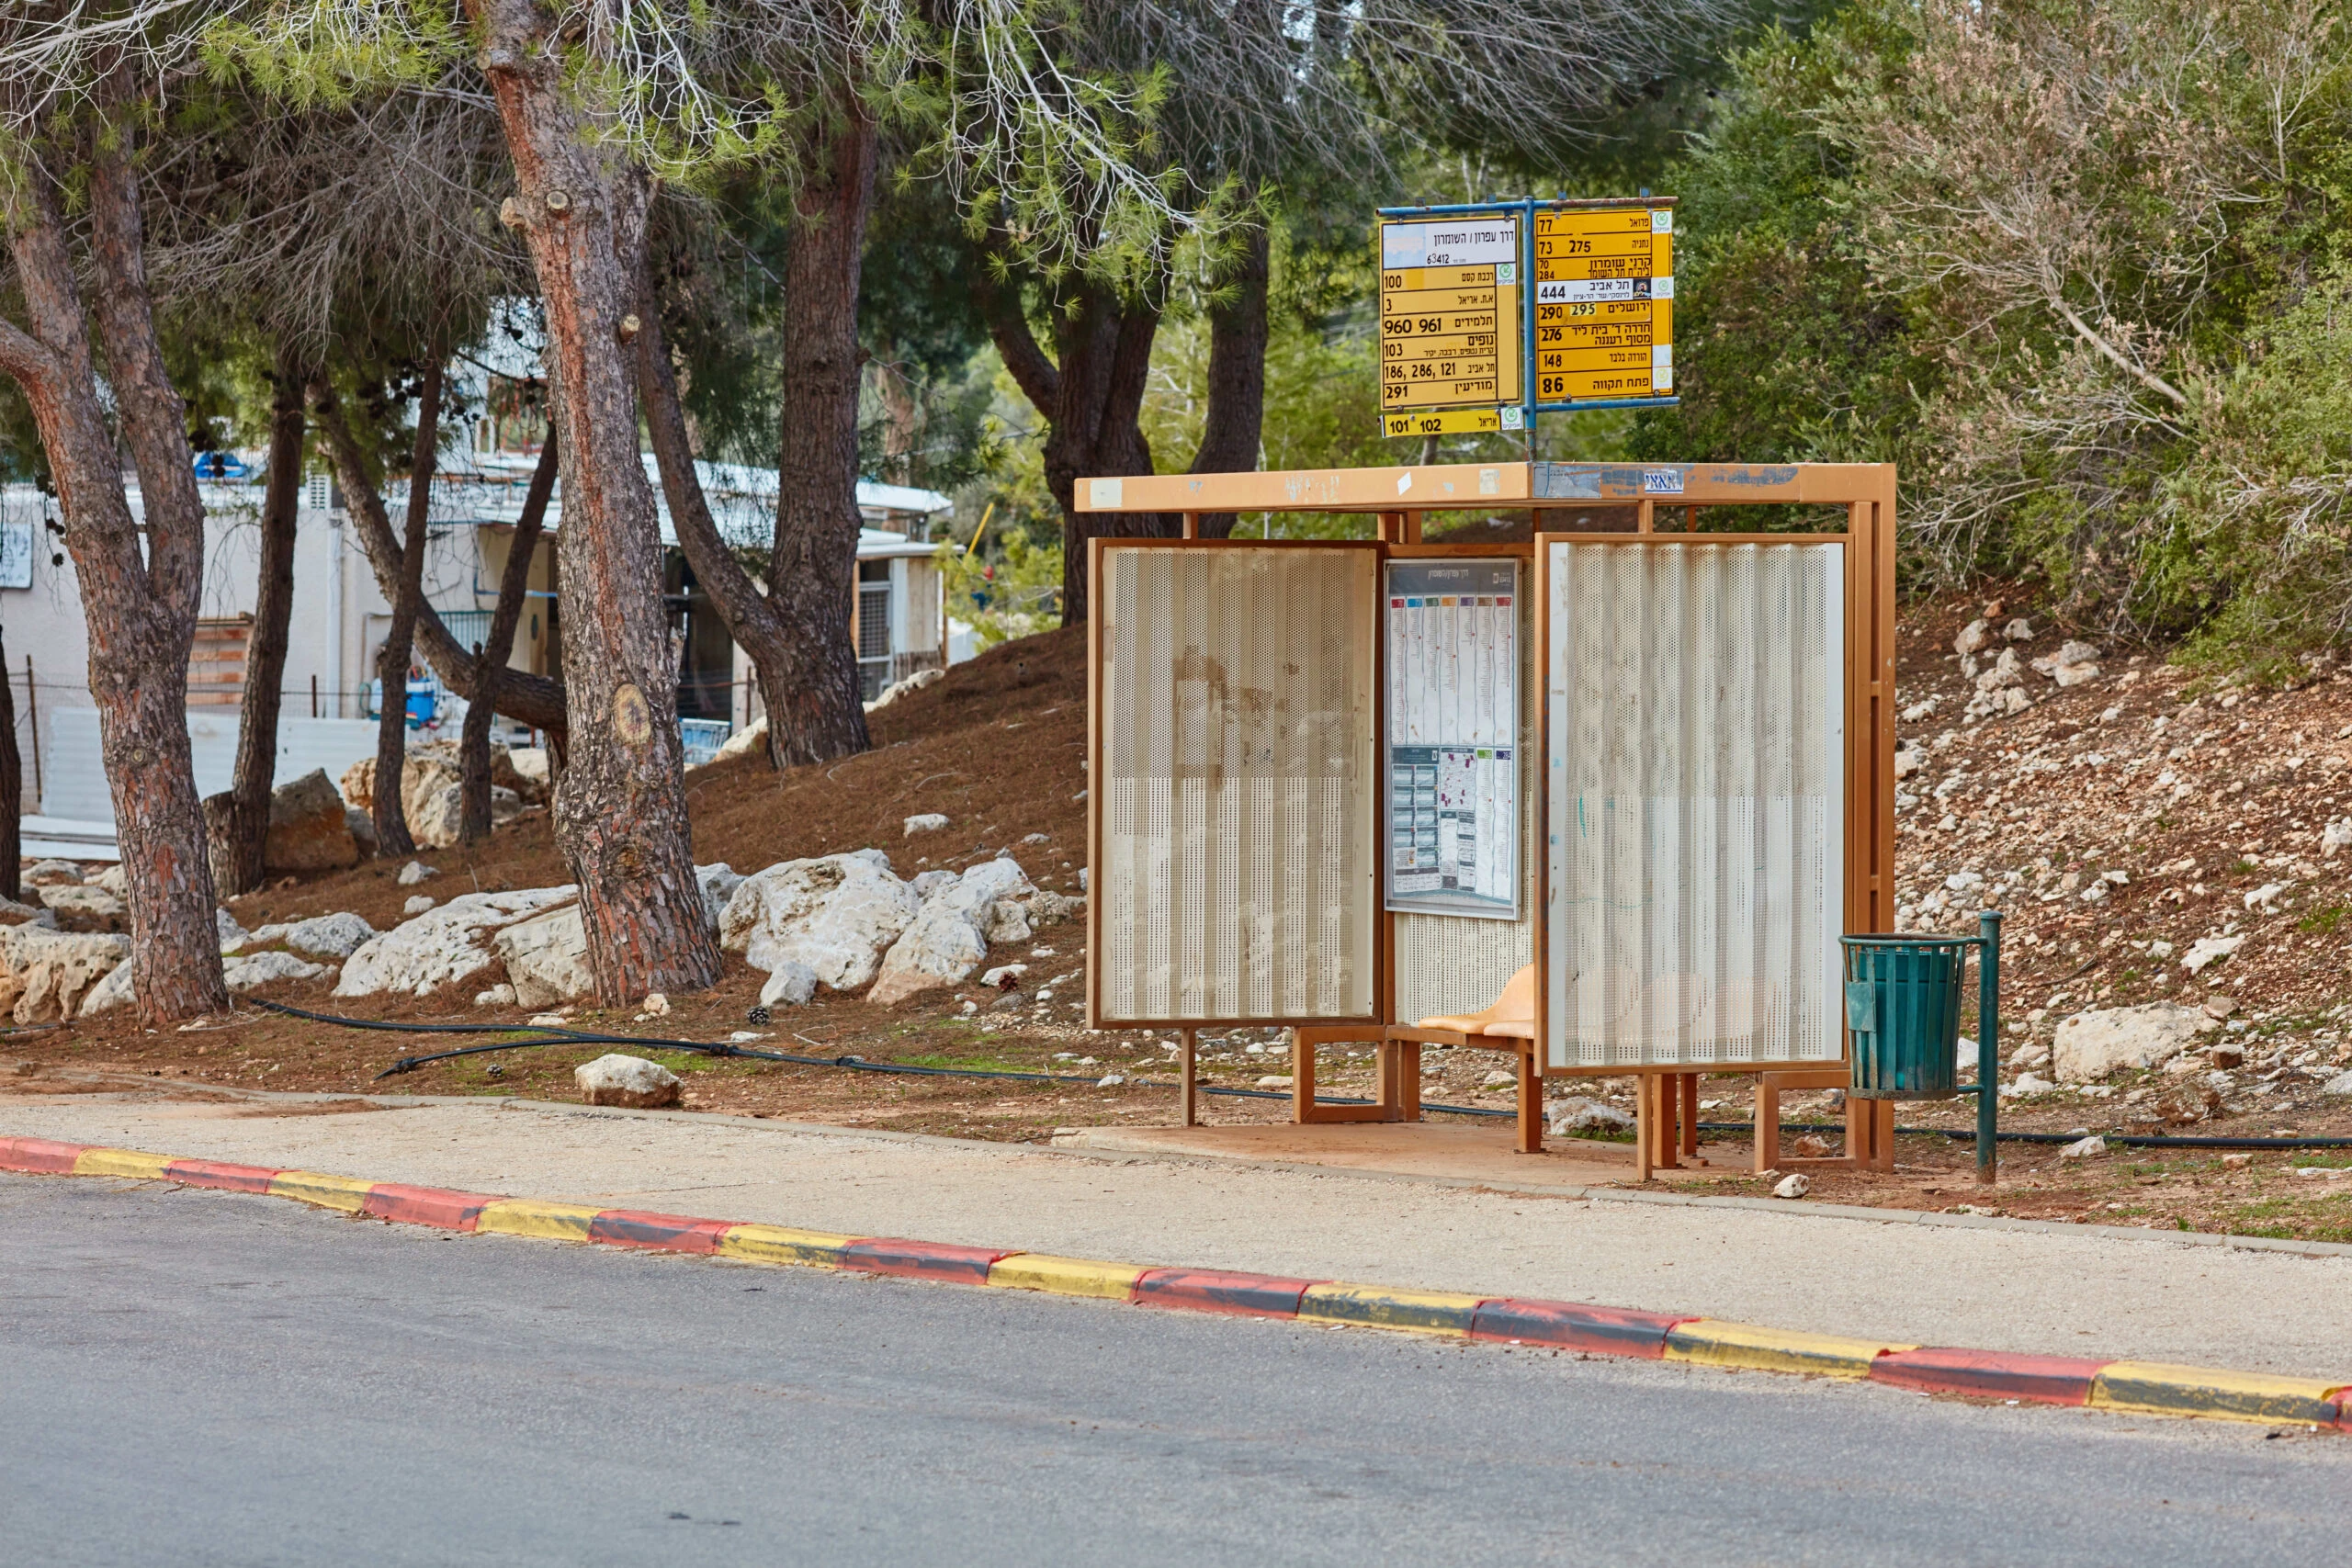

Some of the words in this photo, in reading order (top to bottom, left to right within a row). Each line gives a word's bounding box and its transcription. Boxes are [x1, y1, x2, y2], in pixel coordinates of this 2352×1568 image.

[1539, 220, 1553, 232] 77
[1434, 232, 1466, 246] השומרון
[1475, 231, 1497, 244] עפרון
[1499, 231, 1514, 243] דרך
[1539, 242, 1553, 254] 73
[1569, 241, 1591, 253] 275
[1632, 240, 1649, 249] נתניה
[1427, 254, 1450, 265] 63412
[1539, 260, 1549, 269] 70
[1589, 258, 1625, 270] שומרון
[1630, 257, 1651, 268] קרני
[1477, 272, 1494, 282] רכבת
[1539, 271, 1555, 280] 284
[1615, 267, 1625, 277] תל
[1385, 276, 1402, 288] 100
[1462, 273, 1476, 283] קסם
[1589, 281, 1612, 291] אביב
[1616, 280, 1630, 290] תל
[1540, 286, 1566, 299] 444
[1386, 299, 1392, 311] 3
[1458, 295, 1478, 305] אריאל
[1540, 307, 1562, 320] 290
[1571, 303, 1595, 316] 295
[1608, 302, 1650, 313] ירושלים
[1385, 319, 1412, 333] 960
[1419, 318, 1442, 332] 961
[1454, 315, 1493, 328] תלמידים
[1572, 325, 1588, 335] ליד
[1591, 326, 1608, 334] בית
[1625, 324, 1650, 334] חדרה
[1467, 334, 1494, 346] נופים
[1541, 328, 1563, 342] 276
[1595, 335, 1623, 345] רעננה
[1626, 334, 1651, 345] מסוף
[1385, 344, 1403, 356] 103
[1479, 346, 1494, 355] קרית
[1544, 354, 1562, 367] 148
[1609, 353, 1625, 363] בלבד
[1627, 353, 1647, 363] הורדה
[1385, 365, 1407, 381] 186,
[1412, 364, 1436, 379] 286,
[1441, 362, 1455, 376] 121
[1467, 364, 1484, 374] אביב
[1486, 362, 1496, 373] תל
[1454, 380, 1493, 394] מודיעין
[1543, 378, 1564, 393] 86
[1593, 378, 1623, 391] תקווה
[1626, 377, 1649, 388] פתח
[1385, 385, 1408, 399] 291
[1390, 420, 1408, 433] 101
[1420, 419, 1442, 433] 102
[1478, 417, 1498, 427] אריאל
